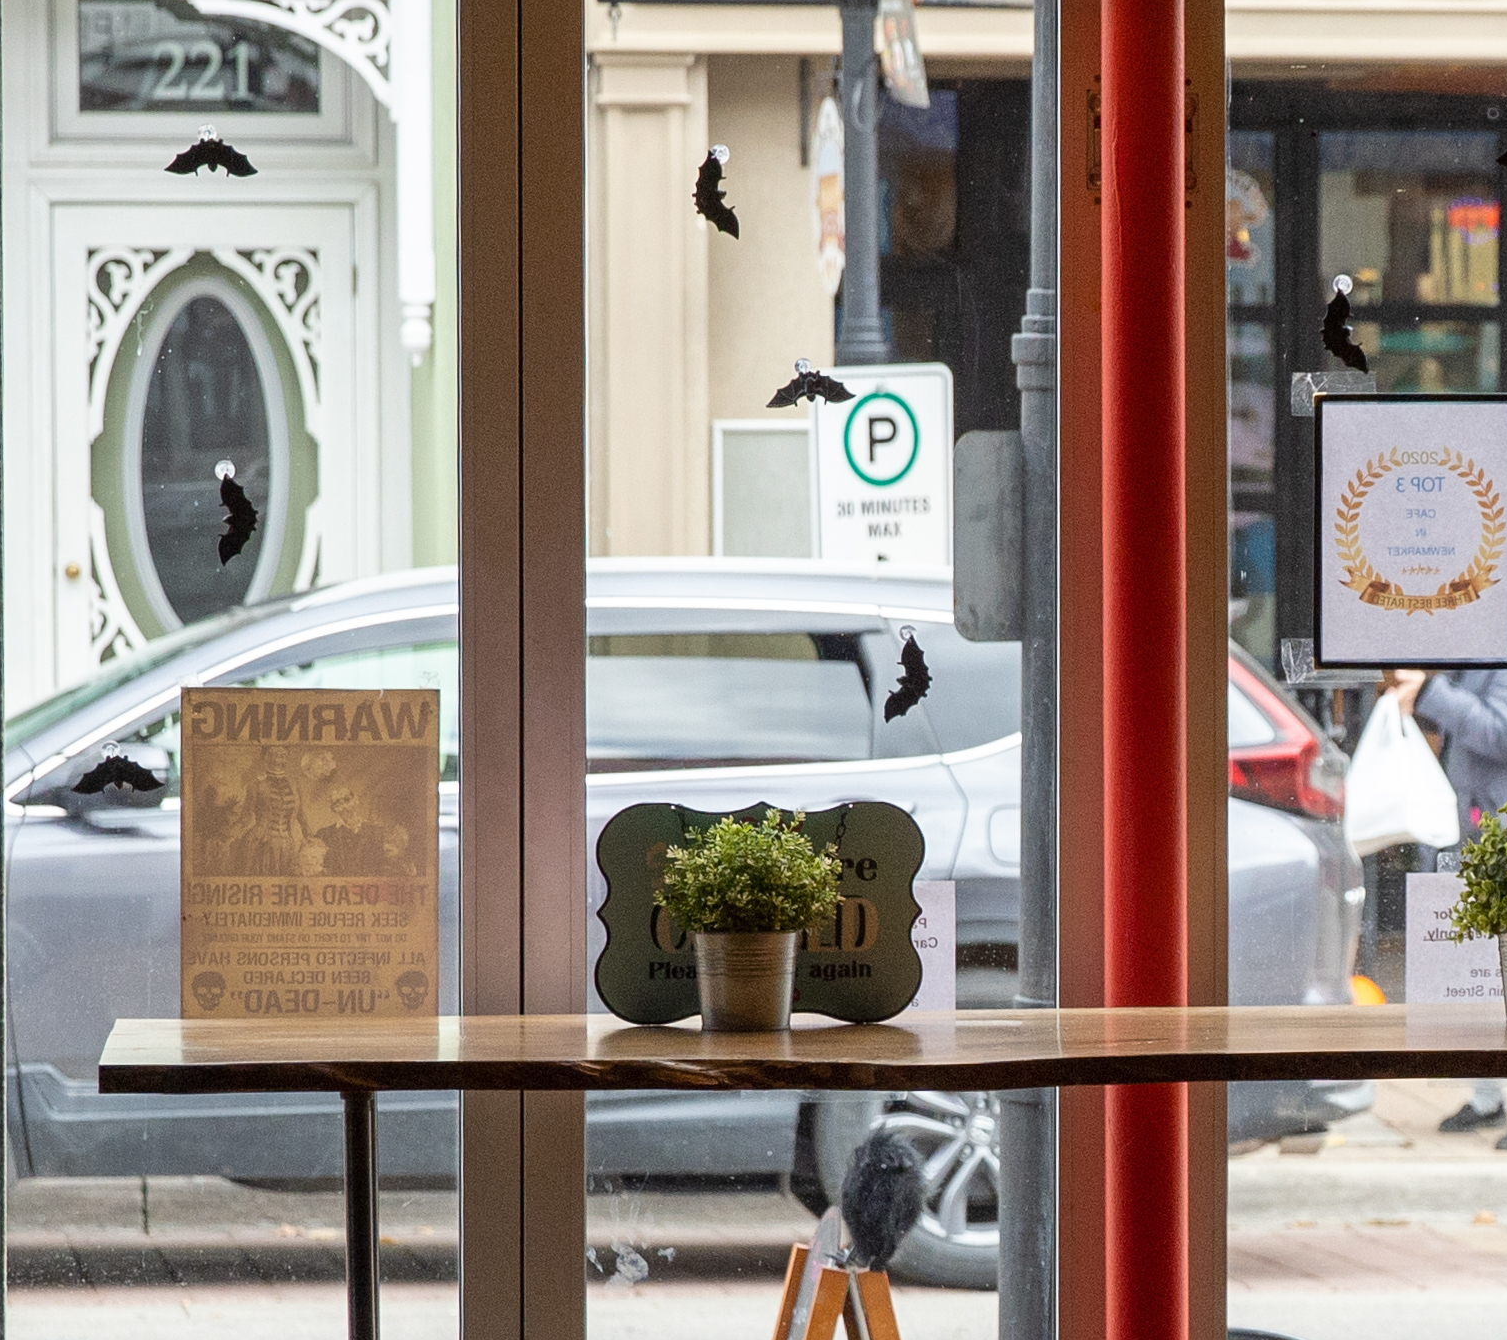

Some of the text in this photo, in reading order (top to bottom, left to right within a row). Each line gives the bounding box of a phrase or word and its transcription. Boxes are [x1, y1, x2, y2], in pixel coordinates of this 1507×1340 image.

[153, 40, 255, 100] 221
[868, 416, 897, 464] P
[861, 496, 931, 516] MINUTES
[868, 522, 902, 538] MAX
[809, 964, 872, 979] again
